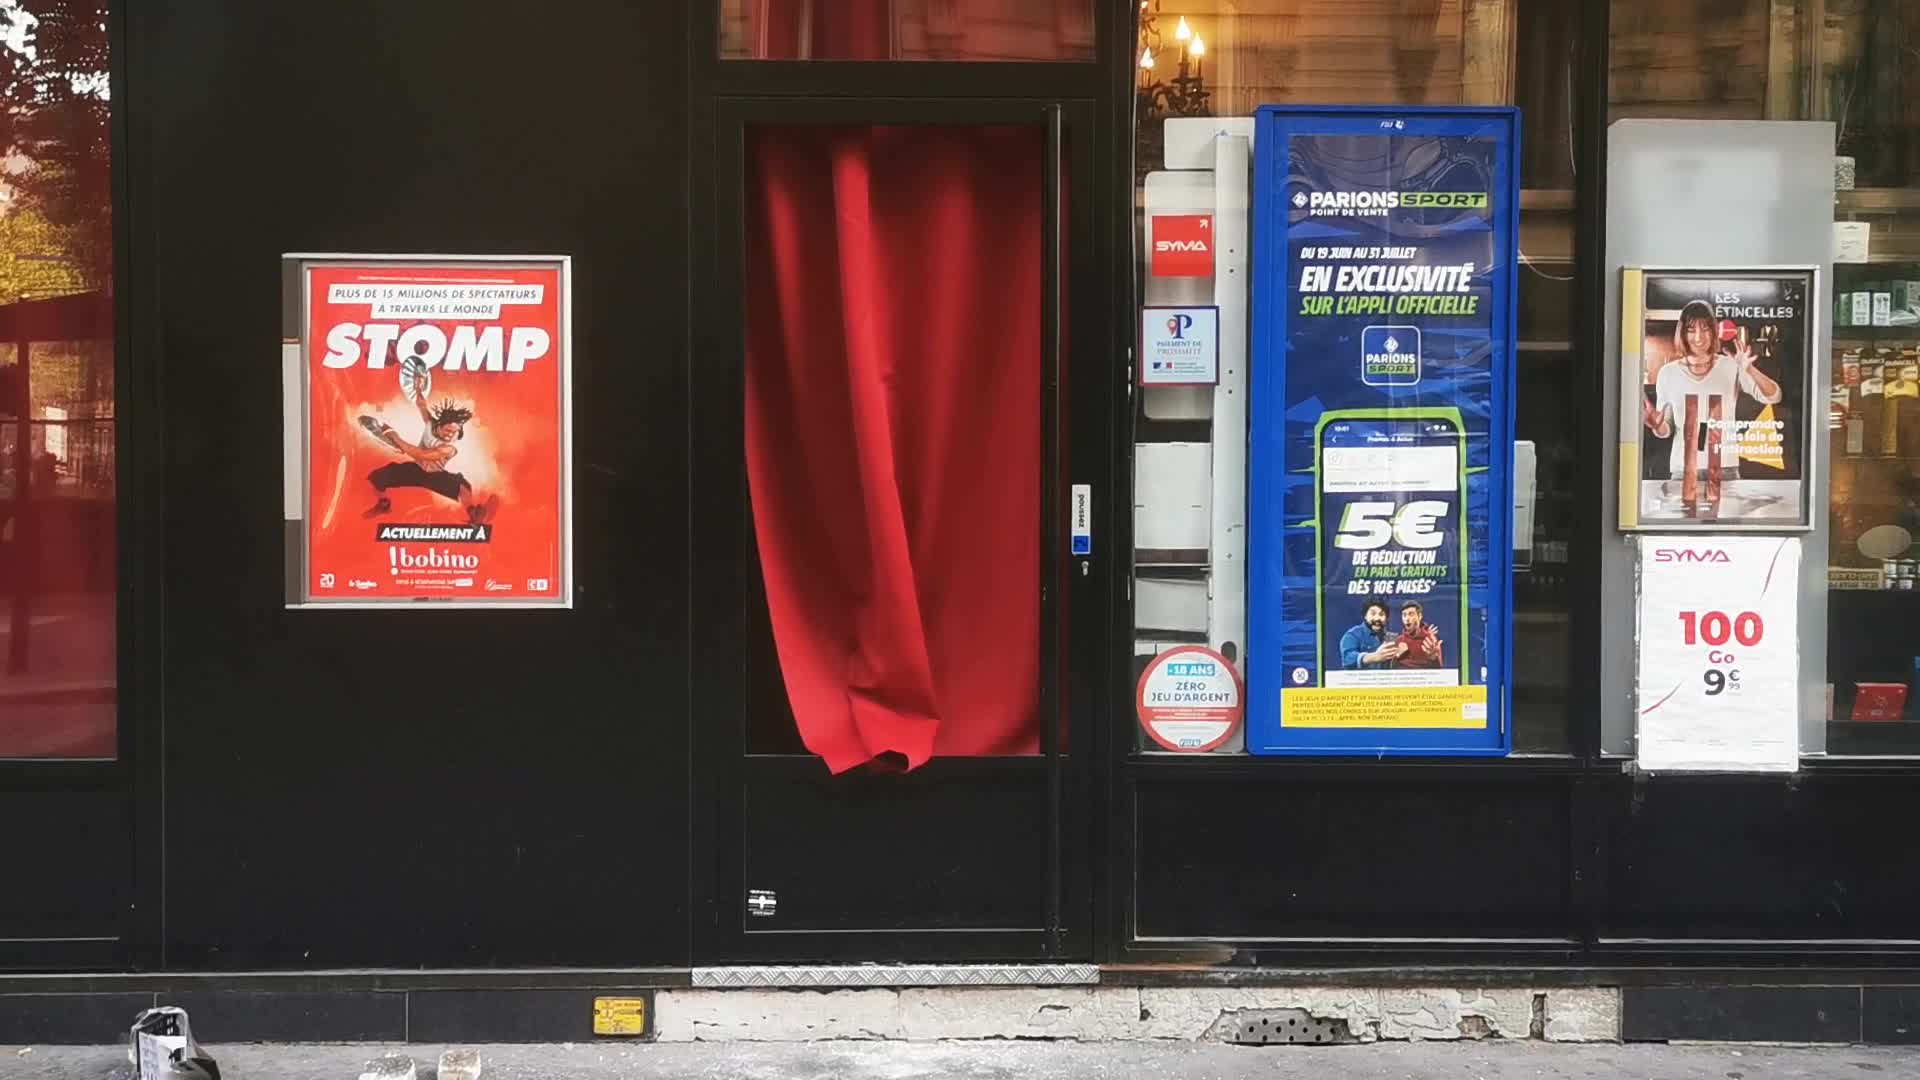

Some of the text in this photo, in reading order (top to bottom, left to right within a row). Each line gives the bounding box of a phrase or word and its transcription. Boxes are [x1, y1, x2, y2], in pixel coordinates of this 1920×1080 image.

[1310, 191, 1485, 208] PARIONS SPORT
[1310, 208, 1389, 216] POINT DE VENTE
[1156, 240, 1208, 251] SYMA
[1300, 247, 1417, 259] DU 19 JUIN AU 31 JUILLET
[1300, 263, 1475, 292] EN EXCLUSIVITÉ
[335, 289, 537, 299] PLUS DE 15 MILLIONS DE SPECTATEURS
[1715, 293, 1741, 304] LES
[390, 304, 436, 314] TRAVERS
[439, 305, 450, 314] LE
[453, 304, 494, 314] MONDE
[1300, 296, 1479, 314] SUR L'APPLI OFFICIELLE
[1715, 305, 1794, 318] ÉTINCELLES
[322, 322, 550, 372] STOMP
[1366, 353, 1416, 374] PARIONS SPORT
[1334, 501, 1449, 549] 5€
[380, 526, 487, 540] ACTUELLEMENT À
[1352, 549, 1437, 565] DE RÉDUCTION
[1655, 549, 1731, 562] SYMA
[1354, 565, 1448, 577] EN PARIS GRATUITS
[1679, 611, 1764, 647] 100
[1709, 650, 1735, 664] Go
[1190, 665, 1214, 674] ANS
[1176, 681, 1206, 691] ZÉRO
[1152, 692, 1231, 702] JEU D'ARGENT
